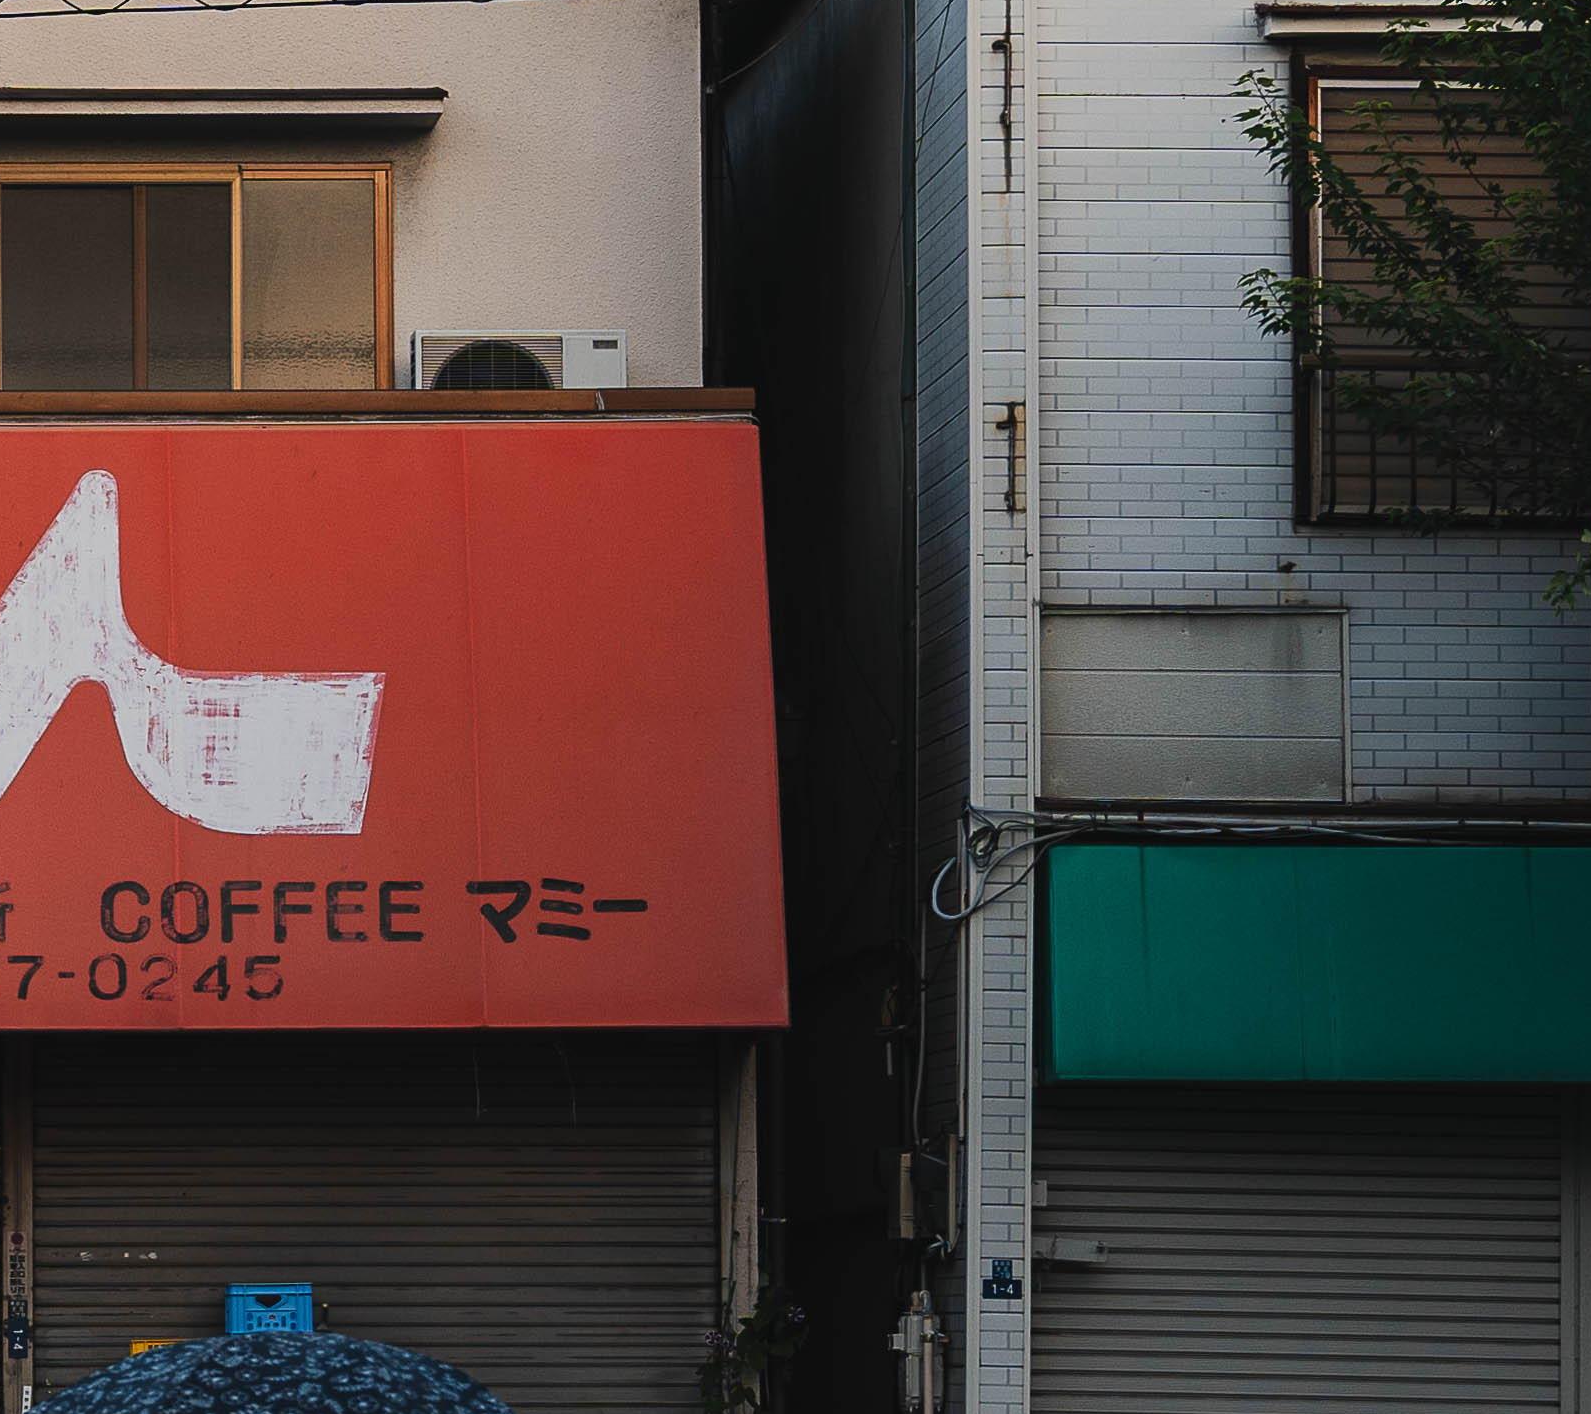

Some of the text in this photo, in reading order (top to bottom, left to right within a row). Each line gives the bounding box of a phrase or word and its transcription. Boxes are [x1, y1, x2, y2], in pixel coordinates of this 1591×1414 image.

[99, 879, 424, 944] COFFEE
[465, 877, 649, 944] マミー
[992, 1283, 1014, 1295] 1-4
[12, 1329, 24, 1351] 1-4
